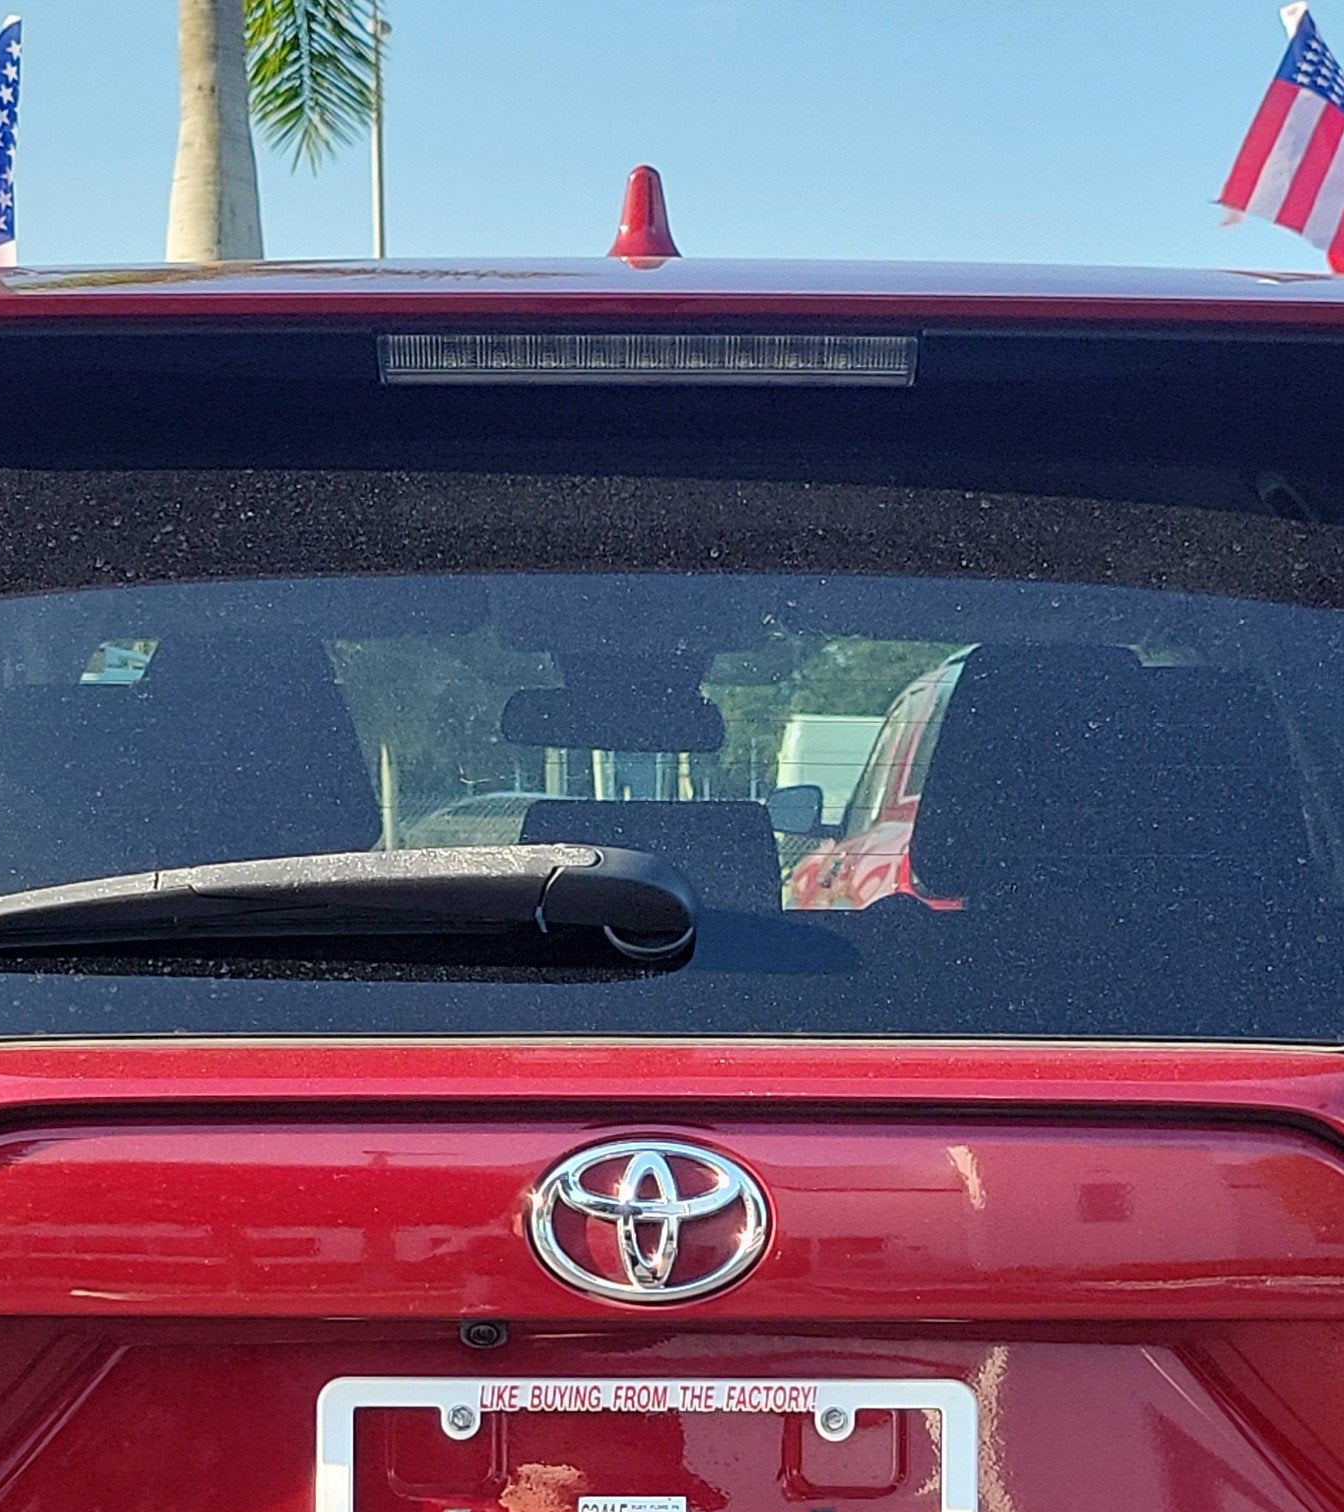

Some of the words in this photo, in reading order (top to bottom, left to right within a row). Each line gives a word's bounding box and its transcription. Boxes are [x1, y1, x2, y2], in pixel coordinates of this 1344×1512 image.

[480, 1385, 519, 1408] LIKE
[530, 1385, 601, 1409] BUYING
[610, 1385, 667, 1410] FROM
[679, 1386, 714, 1410] THE
[723, 1386, 818, 1411] FACTORY!
